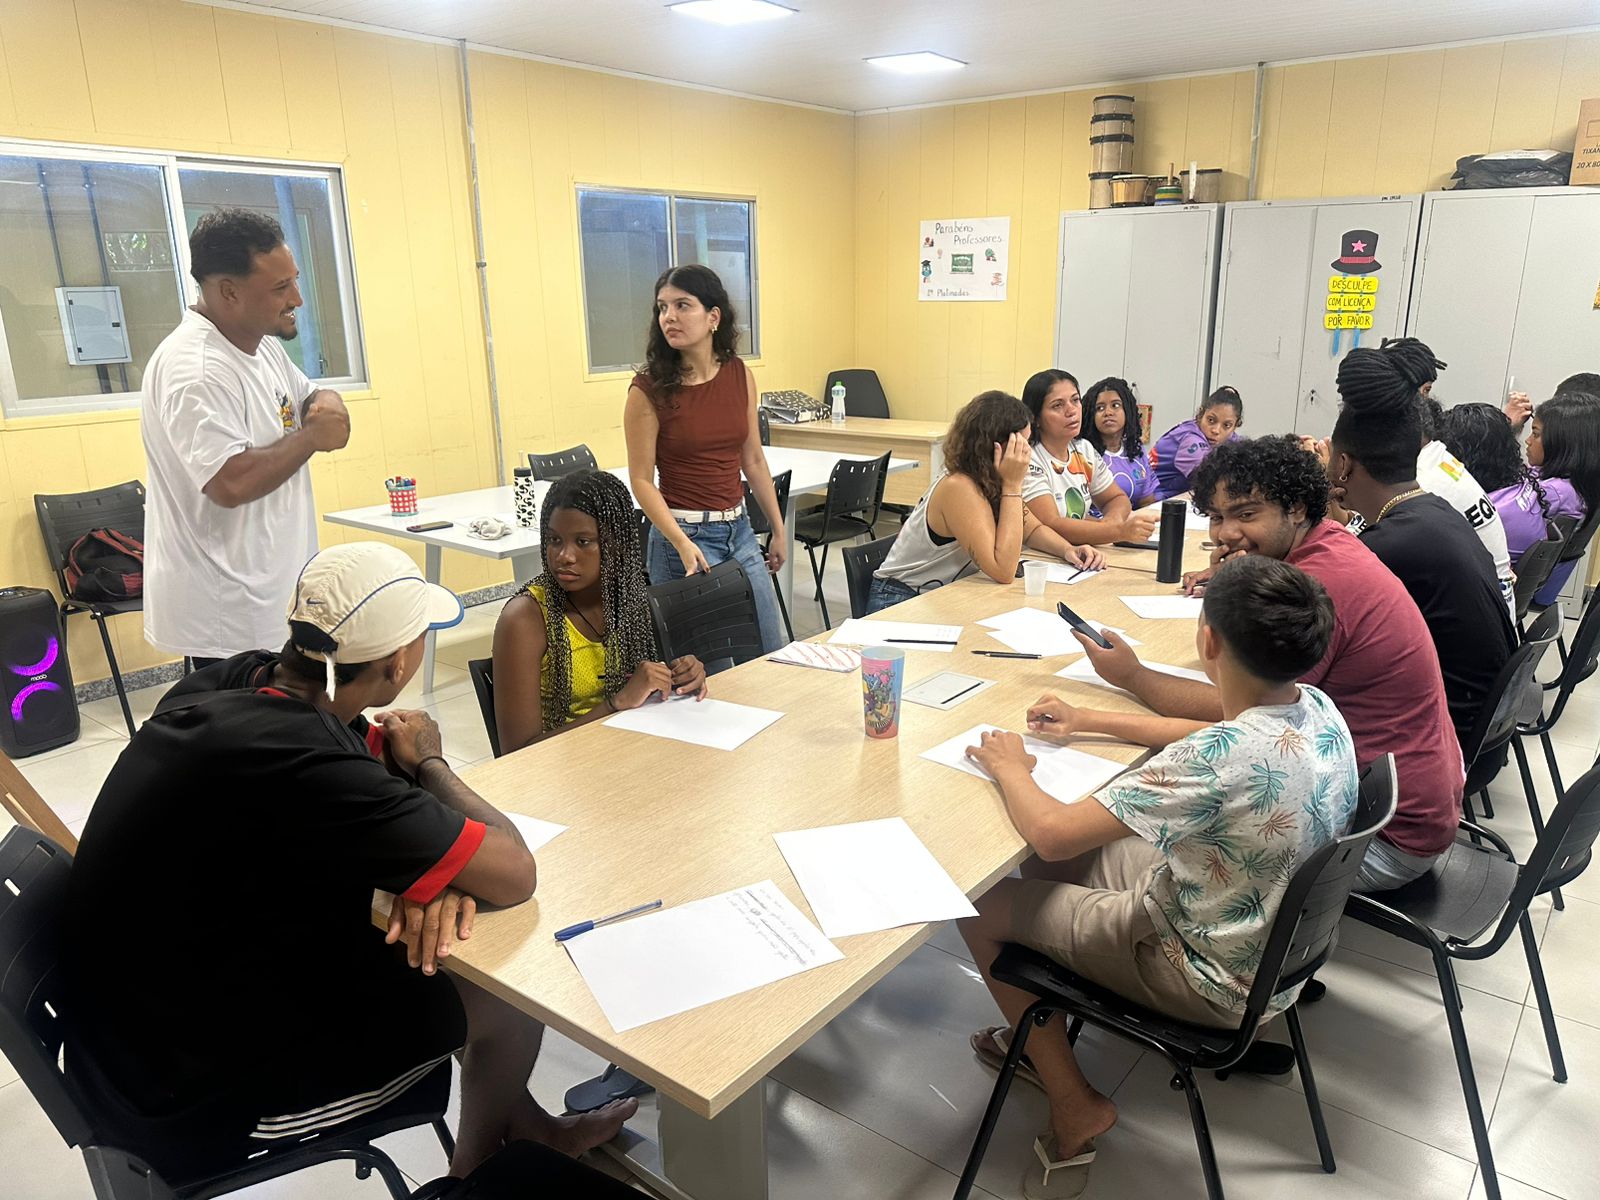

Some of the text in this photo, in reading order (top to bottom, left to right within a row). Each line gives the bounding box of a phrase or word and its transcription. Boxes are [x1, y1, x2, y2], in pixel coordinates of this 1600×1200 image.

[935, 221, 974, 235] Parabéns
[954, 235, 1002, 245] Professores
[1332, 280, 1372, 290] DESCULPE
[1328, 298, 1371, 309] COM LICENÇA
[1327, 315, 1371, 327] POR FAVOR
